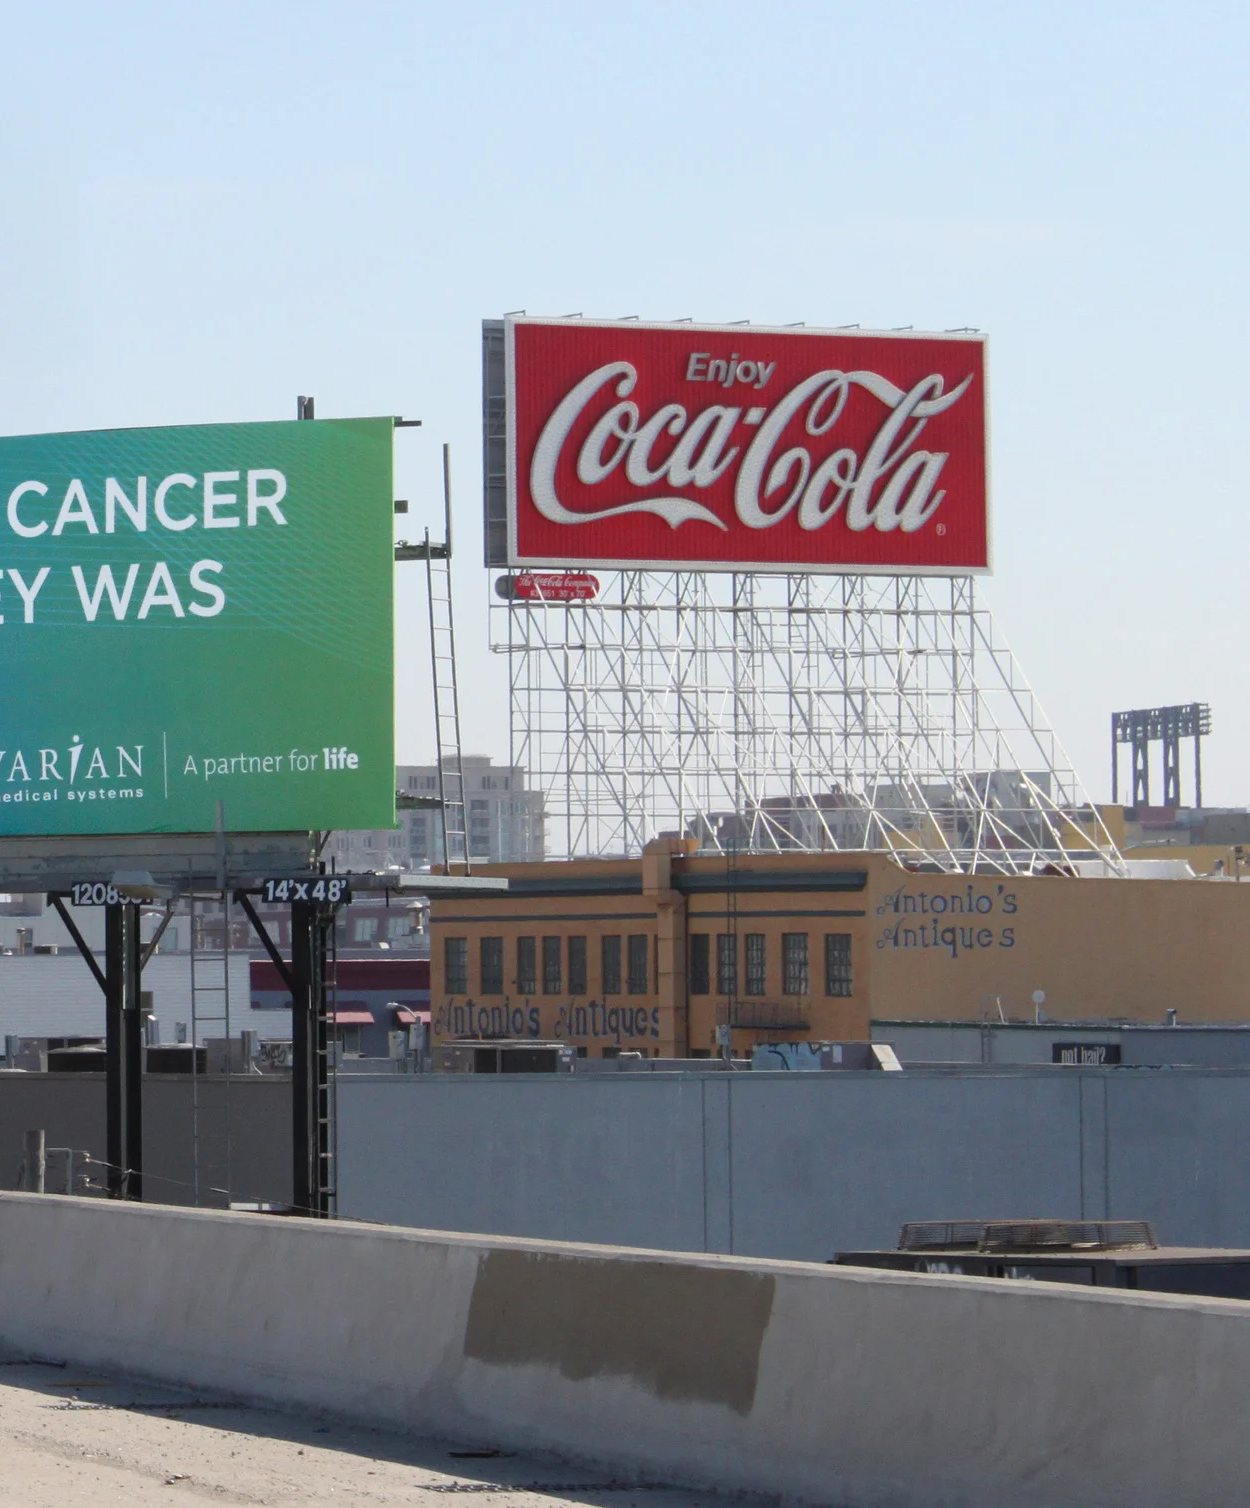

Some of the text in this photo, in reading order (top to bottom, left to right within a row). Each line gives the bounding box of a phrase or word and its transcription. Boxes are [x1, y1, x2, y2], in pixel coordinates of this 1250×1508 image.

[686, 352, 776, 389] Enjoy
[530, 361, 973, 532] Coca-Cola
[7, 468, 288, 538] CANCER
[71, 559, 226, 622] WAS
[183, 747, 359, 781] A partner for life
[68, 787, 144, 803] systems
[877, 885, 1017, 914] Antonio's
[876, 918, 1016, 958] Antiques
[434, 997, 659, 1044] Antonio's Antiques
